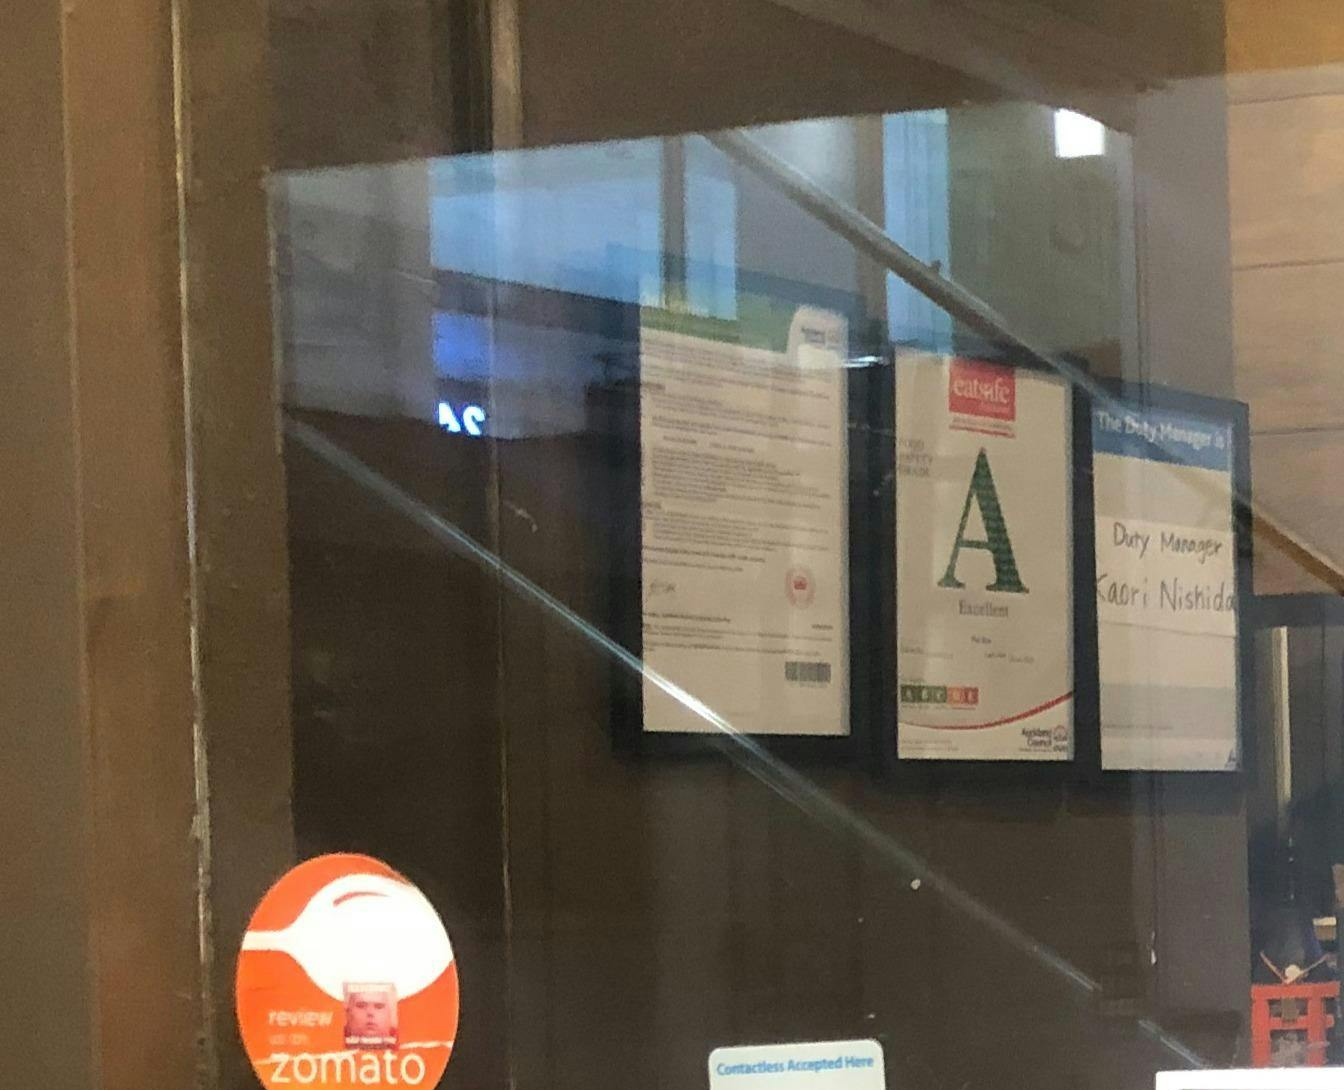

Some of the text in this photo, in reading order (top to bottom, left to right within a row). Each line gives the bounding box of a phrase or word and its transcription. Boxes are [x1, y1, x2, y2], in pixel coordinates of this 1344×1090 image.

[937, 446, 1029, 594] A
[1113, 521, 1223, 564] Duty Manager
[1160, 576, 1235, 613] Nishida
[268, 1008, 334, 1028] review
[270, 1051, 426, 1085] zomato
[716, 1055, 874, 1076] Contactless Accepted Here
